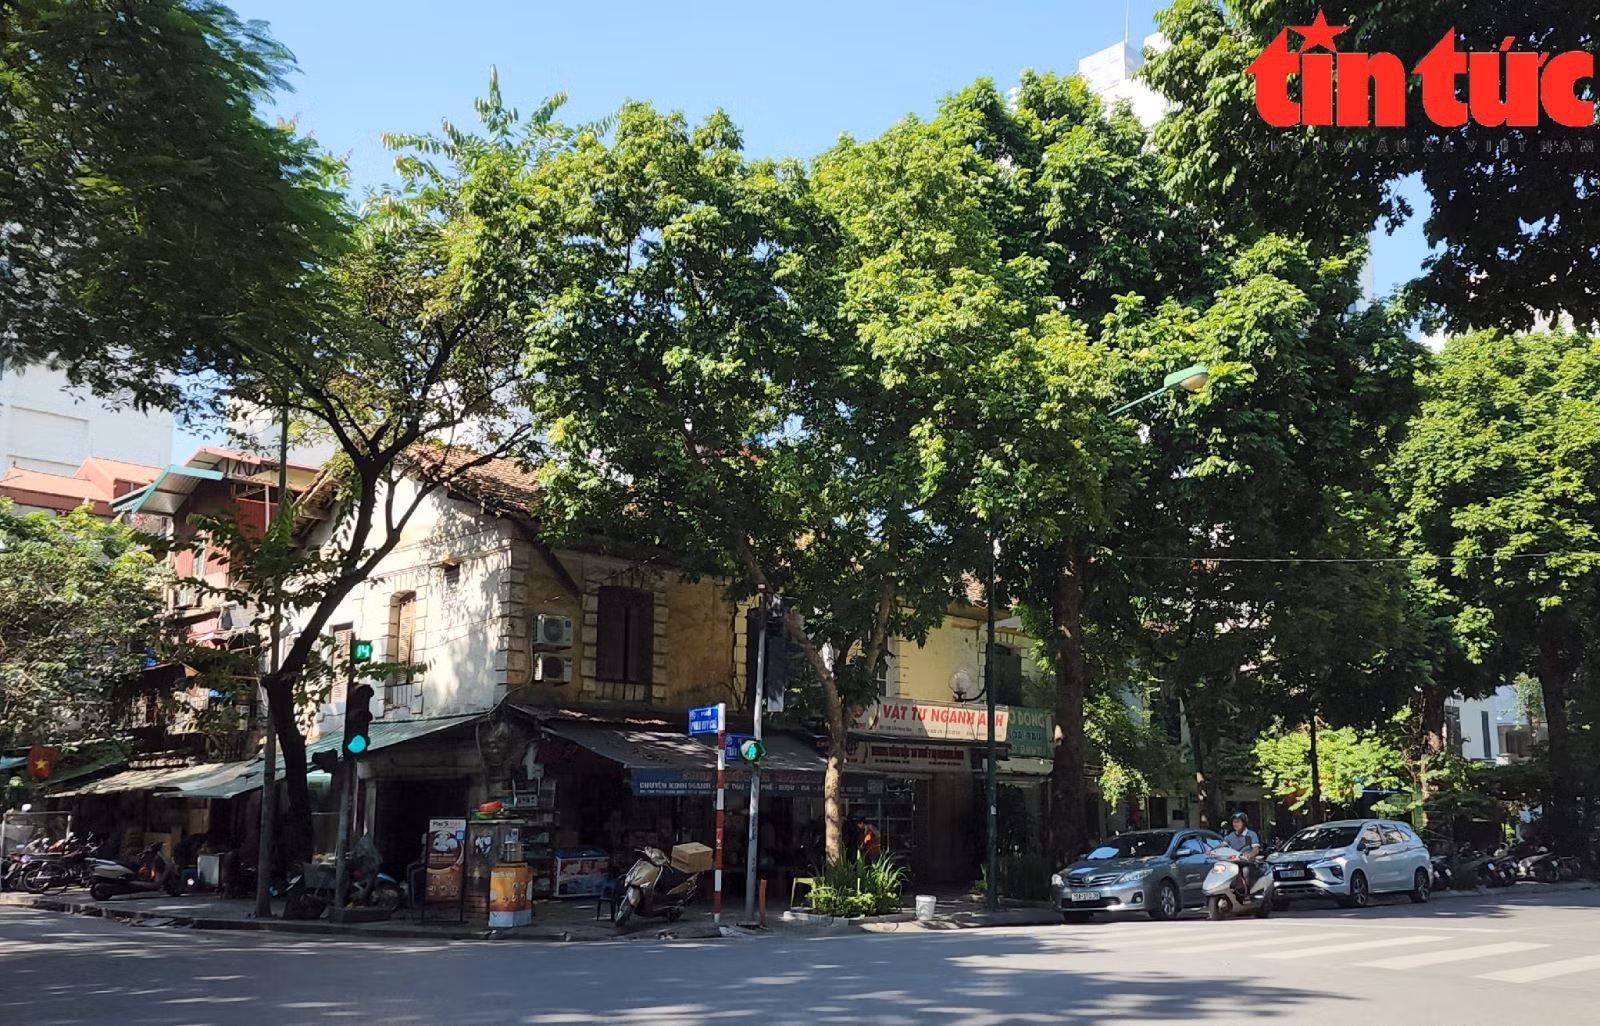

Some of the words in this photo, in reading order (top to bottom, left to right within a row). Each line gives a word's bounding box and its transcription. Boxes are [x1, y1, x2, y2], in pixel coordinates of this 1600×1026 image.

[356, 644, 370, 658] 14
[883, 702, 908, 723] VẬT
[911, 705, 929, 721] TƯ
